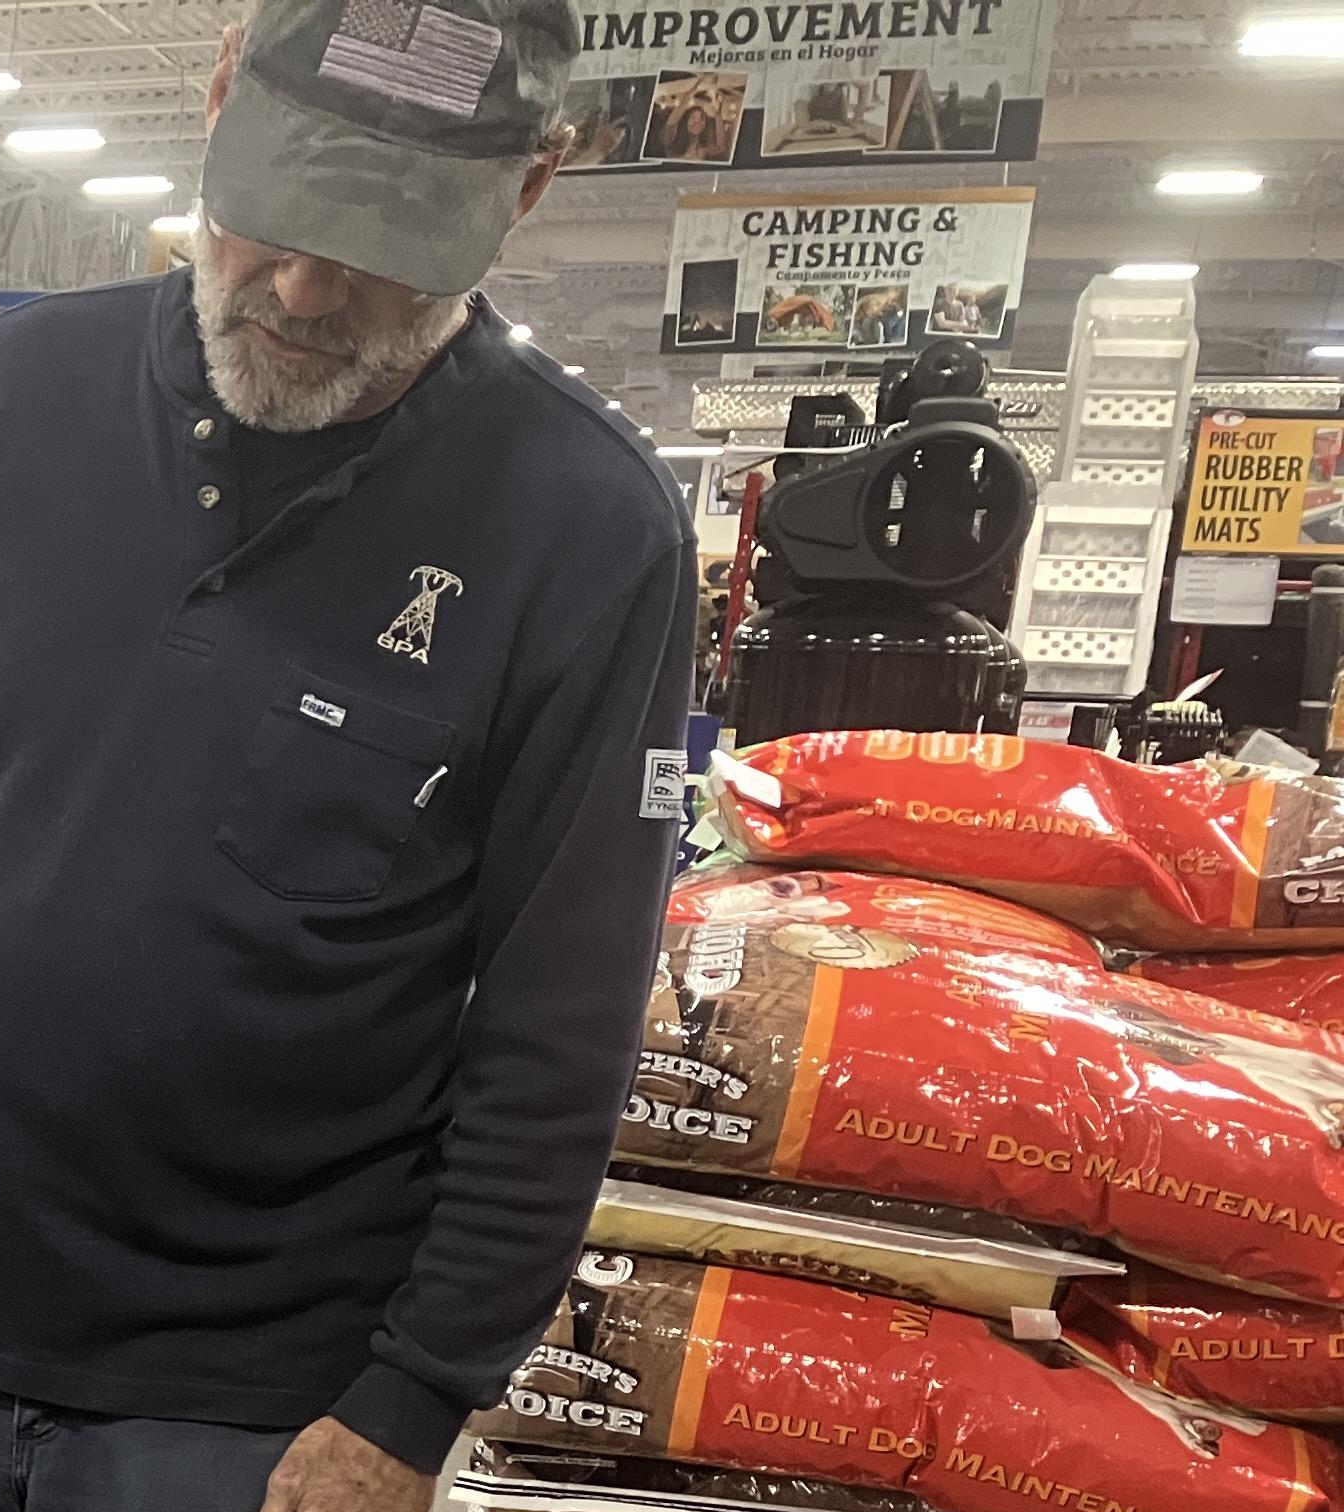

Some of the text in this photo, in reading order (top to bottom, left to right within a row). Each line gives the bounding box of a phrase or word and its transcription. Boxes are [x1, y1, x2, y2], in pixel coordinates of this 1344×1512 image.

[582, 0, 1002, 52] IMPROVEMENT
[689, 43, 879, 66] Mejoras en el Hogar
[742, 206, 958, 237] CAMPING &
[766, 240, 925, 269] FISHING
[1209, 431, 1277, 451] PRE-CUT
[1204, 454, 1304, 482] RUBBER
[1200, 486, 1290, 513] UTILITY
[1193, 516, 1262, 544] MATS
[376, 632, 428, 664] BPA
[905, 800, 976, 827] DOG
[638, 1050, 749, 1101] CHER'S
[621, 1095, 753, 1145] OICE
[834, 1107, 1344, 1246] ADULT DOG MAINTENANC
[1170, 1336, 1314, 1362] ADULT
[525, 1344, 639, 1395] CHER'S
[499, 1386, 645, 1437] OICE
[723, 1402, 857, 1446] ADULT
[868, 1428, 937, 1461] DOG
